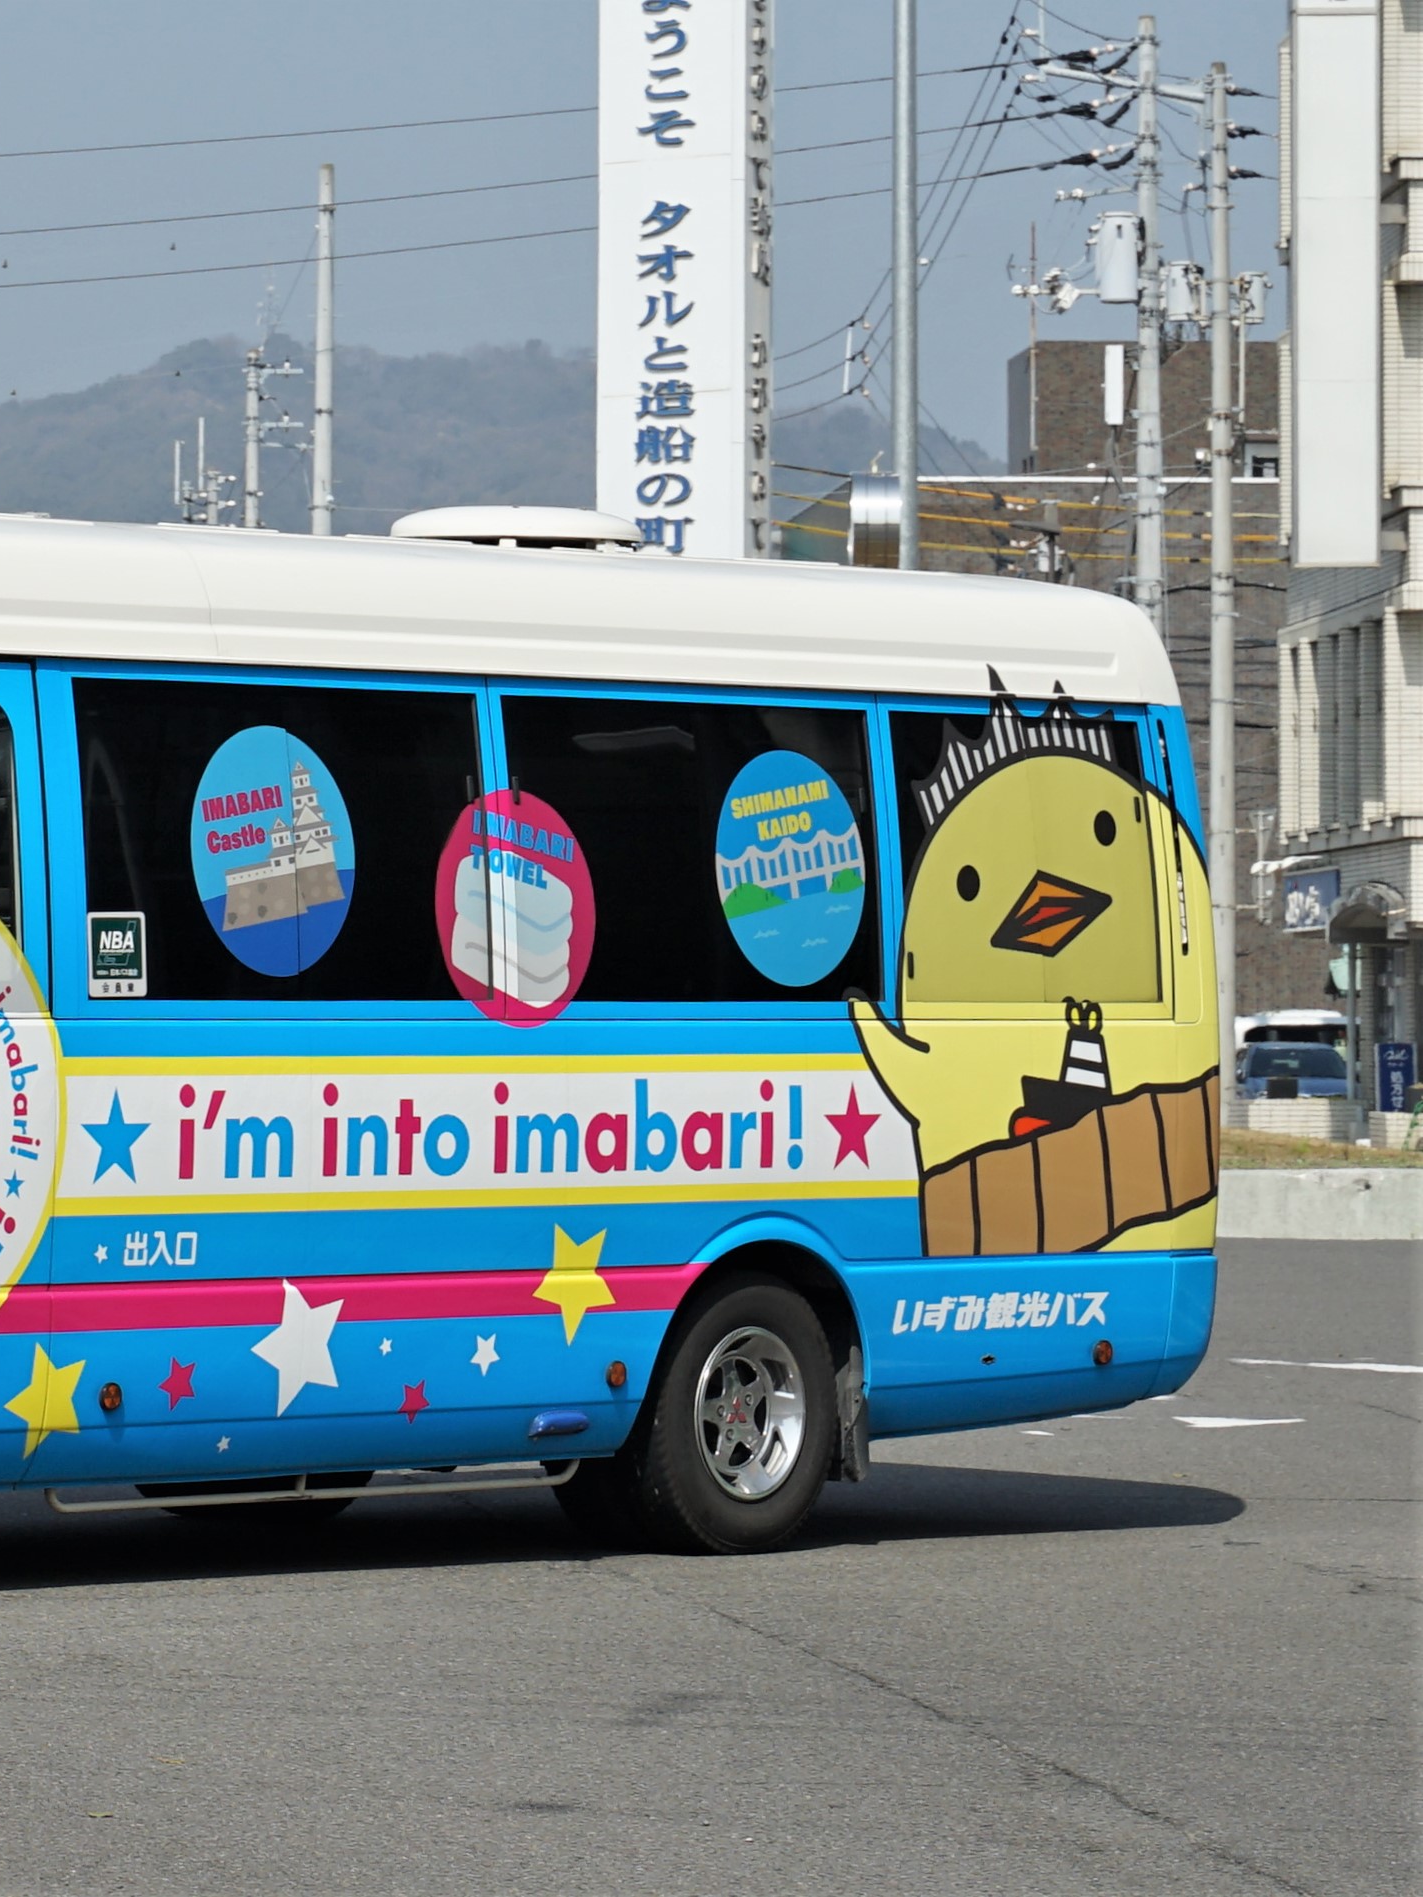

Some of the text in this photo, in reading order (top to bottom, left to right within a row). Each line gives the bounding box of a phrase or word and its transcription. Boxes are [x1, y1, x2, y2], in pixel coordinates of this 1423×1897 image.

[635, 200, 696, 556] タオルと造船の町
[201, 784, 284, 823] IMABARI
[730, 779, 830, 819] SHIMANAMI
[206, 823, 267, 855] Castle
[472, 809, 575, 863] IMABARI
[757, 811, 812, 842] KAIDO
[470, 843, 548, 890] TOWEL
[99, 930, 135, 951] NBA
[178, 1078, 804, 1180] i'm into imabari!
[123, 1230, 198, 1266] 出入口
[892, 1290, 1110, 1335] いずみ観光バス
